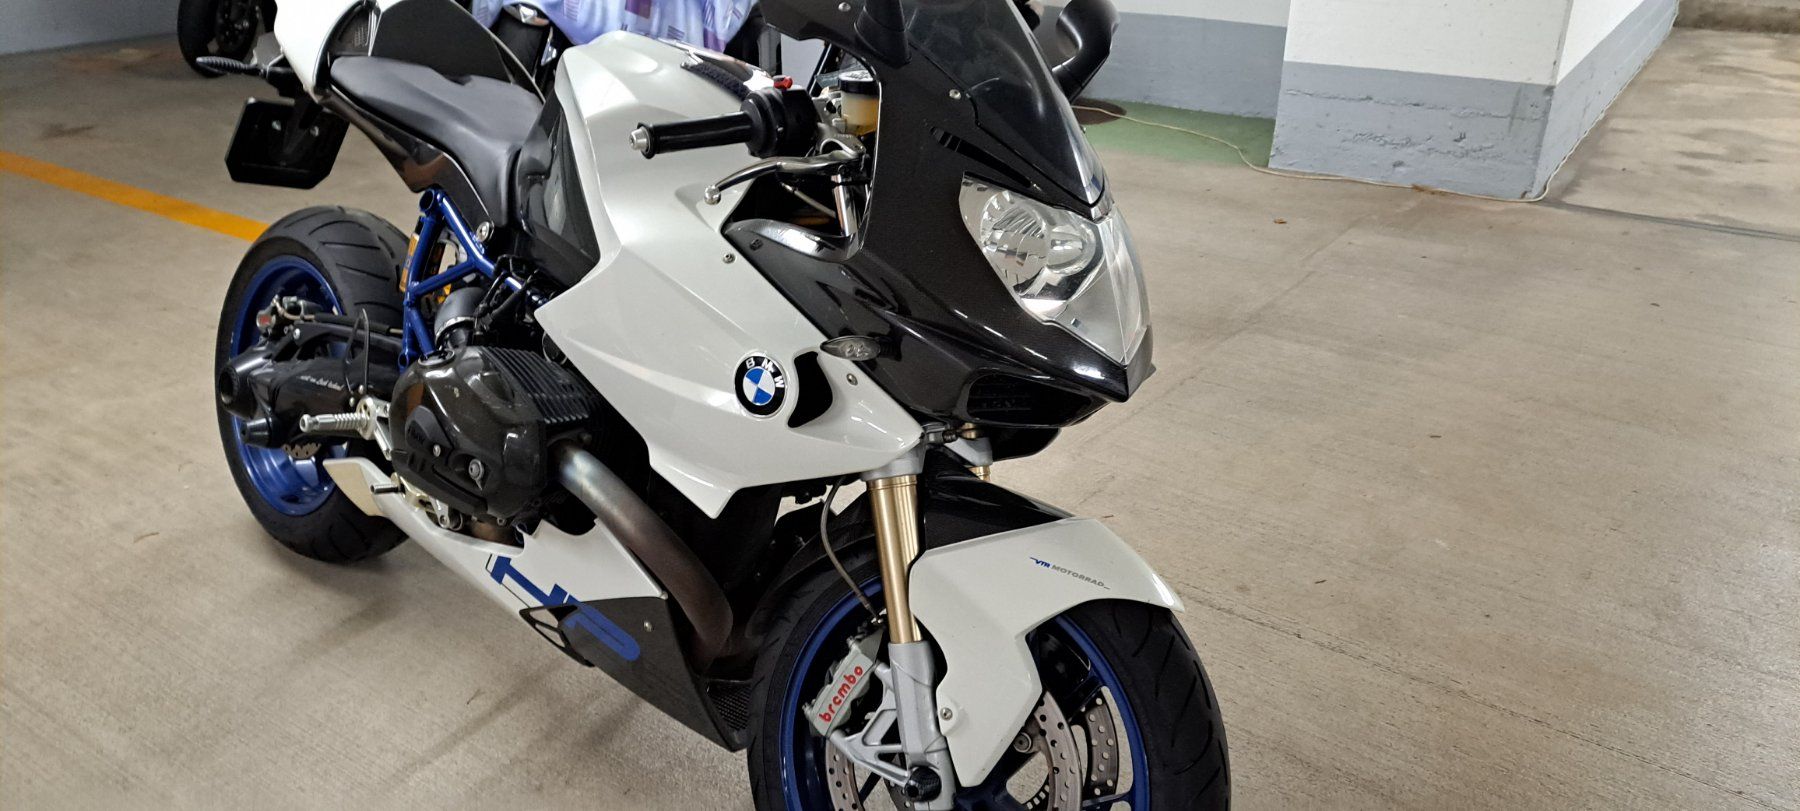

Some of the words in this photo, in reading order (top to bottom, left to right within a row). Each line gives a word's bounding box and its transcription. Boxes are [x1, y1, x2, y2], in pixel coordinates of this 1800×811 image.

[745, 357, 785, 388] BMW
[1051, 564, 1105, 587] MOTORRAD
[819, 665, 863, 722] brembo
